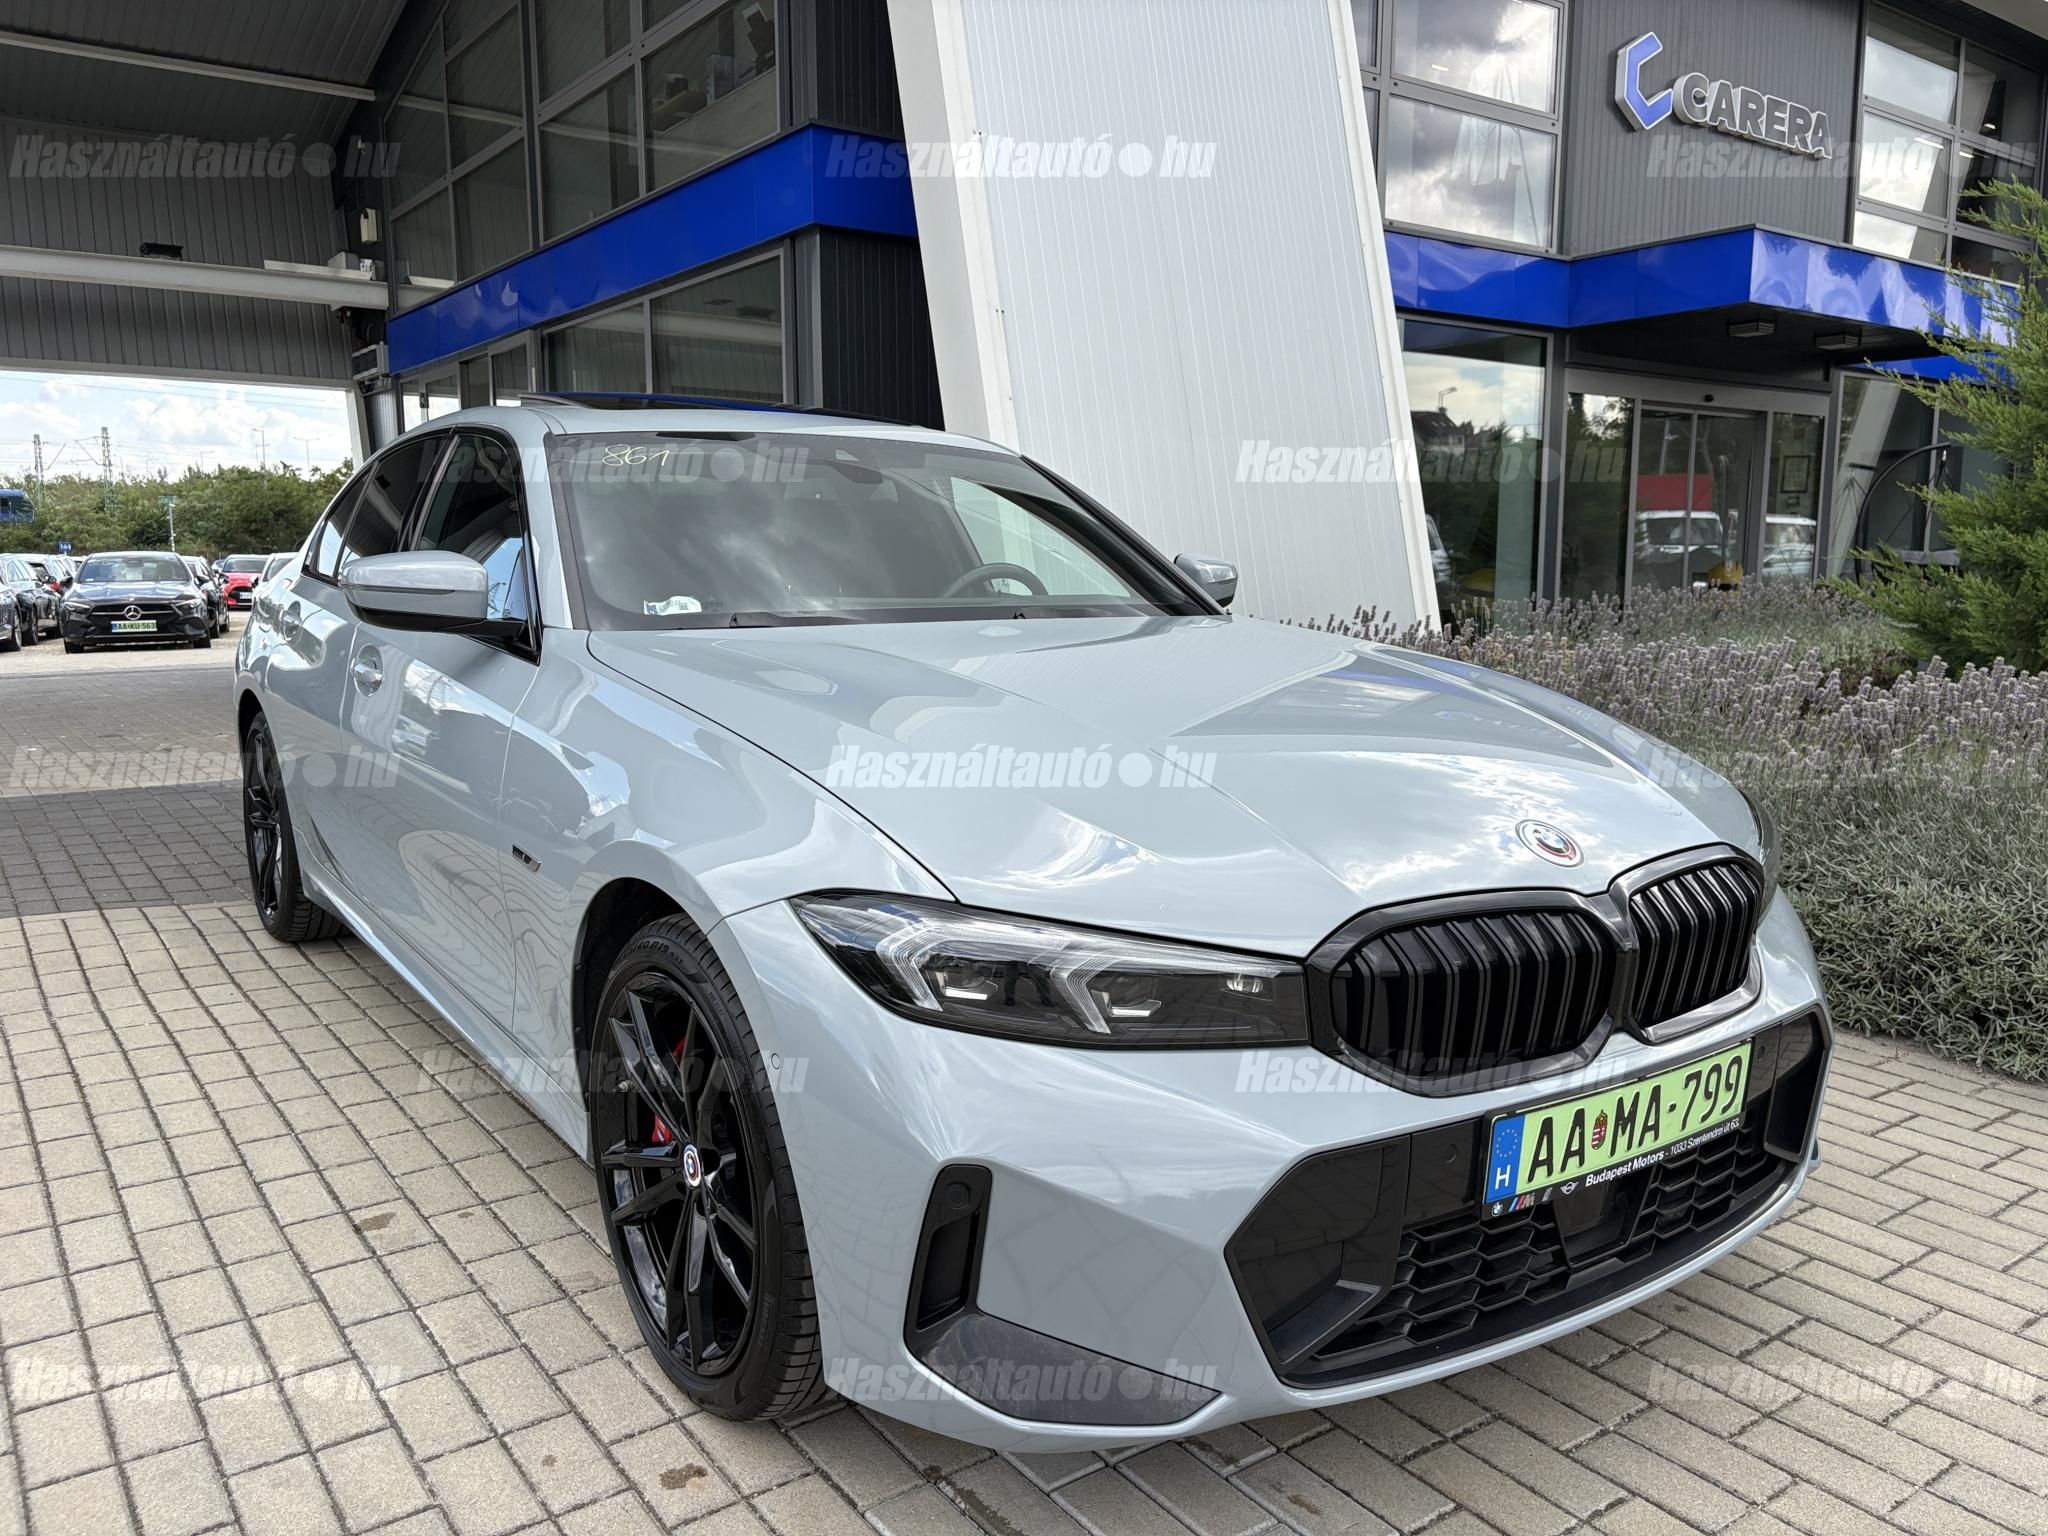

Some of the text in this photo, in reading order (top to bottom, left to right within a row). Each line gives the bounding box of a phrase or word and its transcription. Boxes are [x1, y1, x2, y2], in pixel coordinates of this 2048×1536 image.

[1674, 72, 1832, 160] CARERA
[602, 444, 669, 466] 861
[1495, 1164, 1511, 1190] H
[1585, 1161, 1632, 1187] Budapest
[1633, 1150, 1665, 1171] Motors
[1671, 1141, 1687, 1155] 1033
